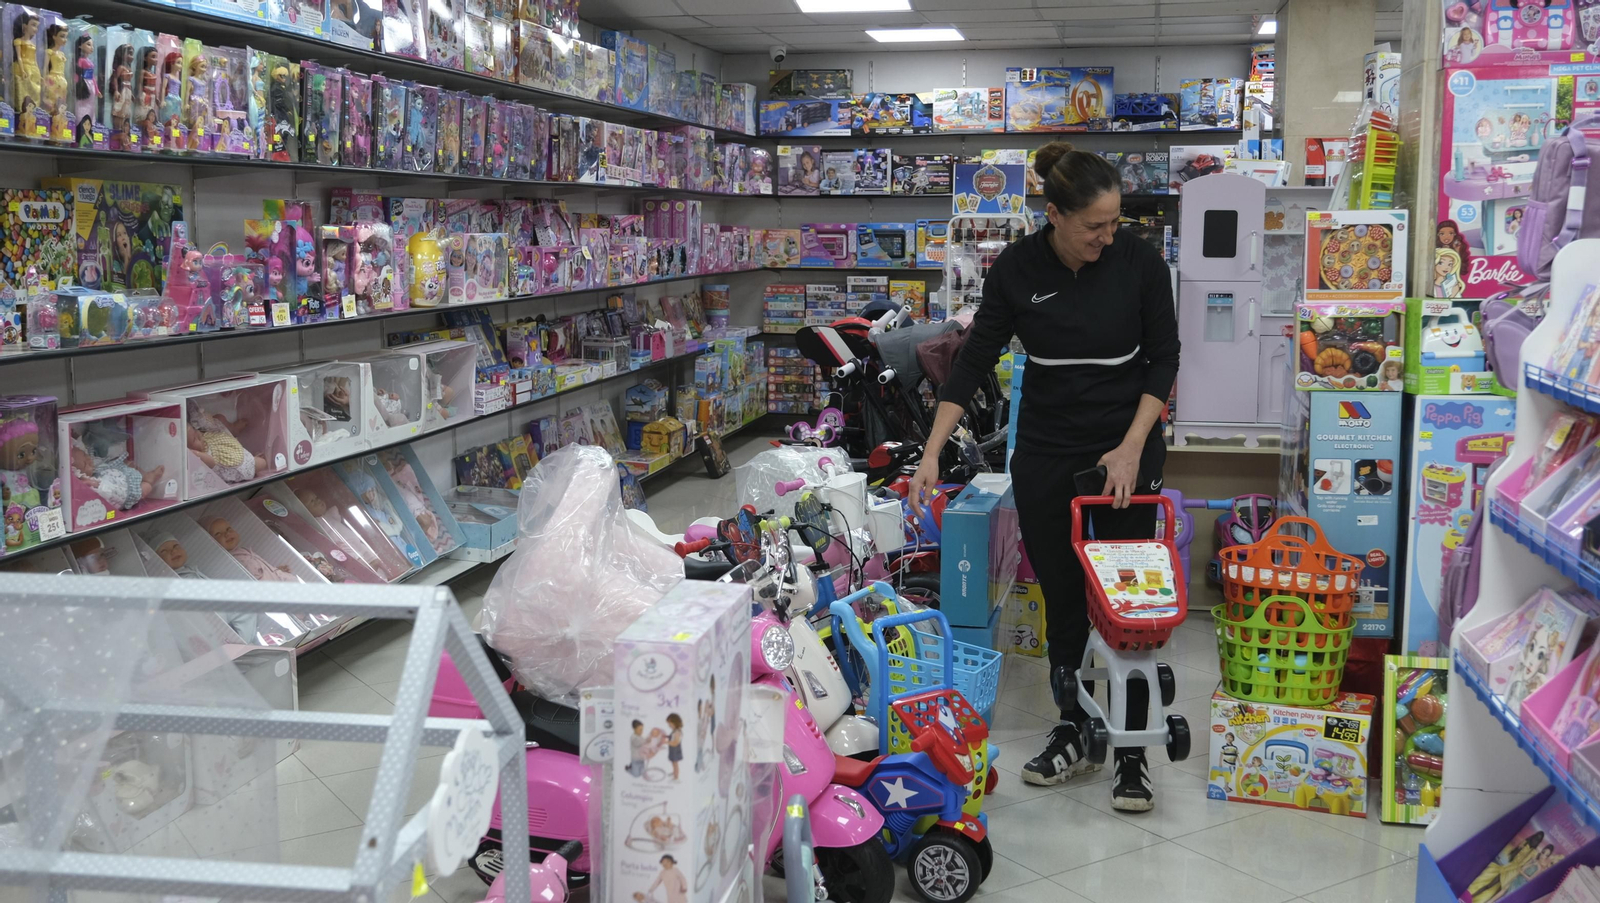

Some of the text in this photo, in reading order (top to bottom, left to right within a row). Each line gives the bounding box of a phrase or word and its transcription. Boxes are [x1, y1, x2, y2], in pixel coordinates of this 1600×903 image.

[1452, 77, 1469, 86] +11
[109, 184, 140, 200] SLIME
[1461, 208, 1473, 216] 53
[1468, 258, 1524, 284] Barbie
[1301, 308, 1311, 317] 21
[1426, 404, 1481, 426] Peppa Pig
[1273, 709, 1299, 717] Kitchen
[1300, 711, 1315, 720] play
